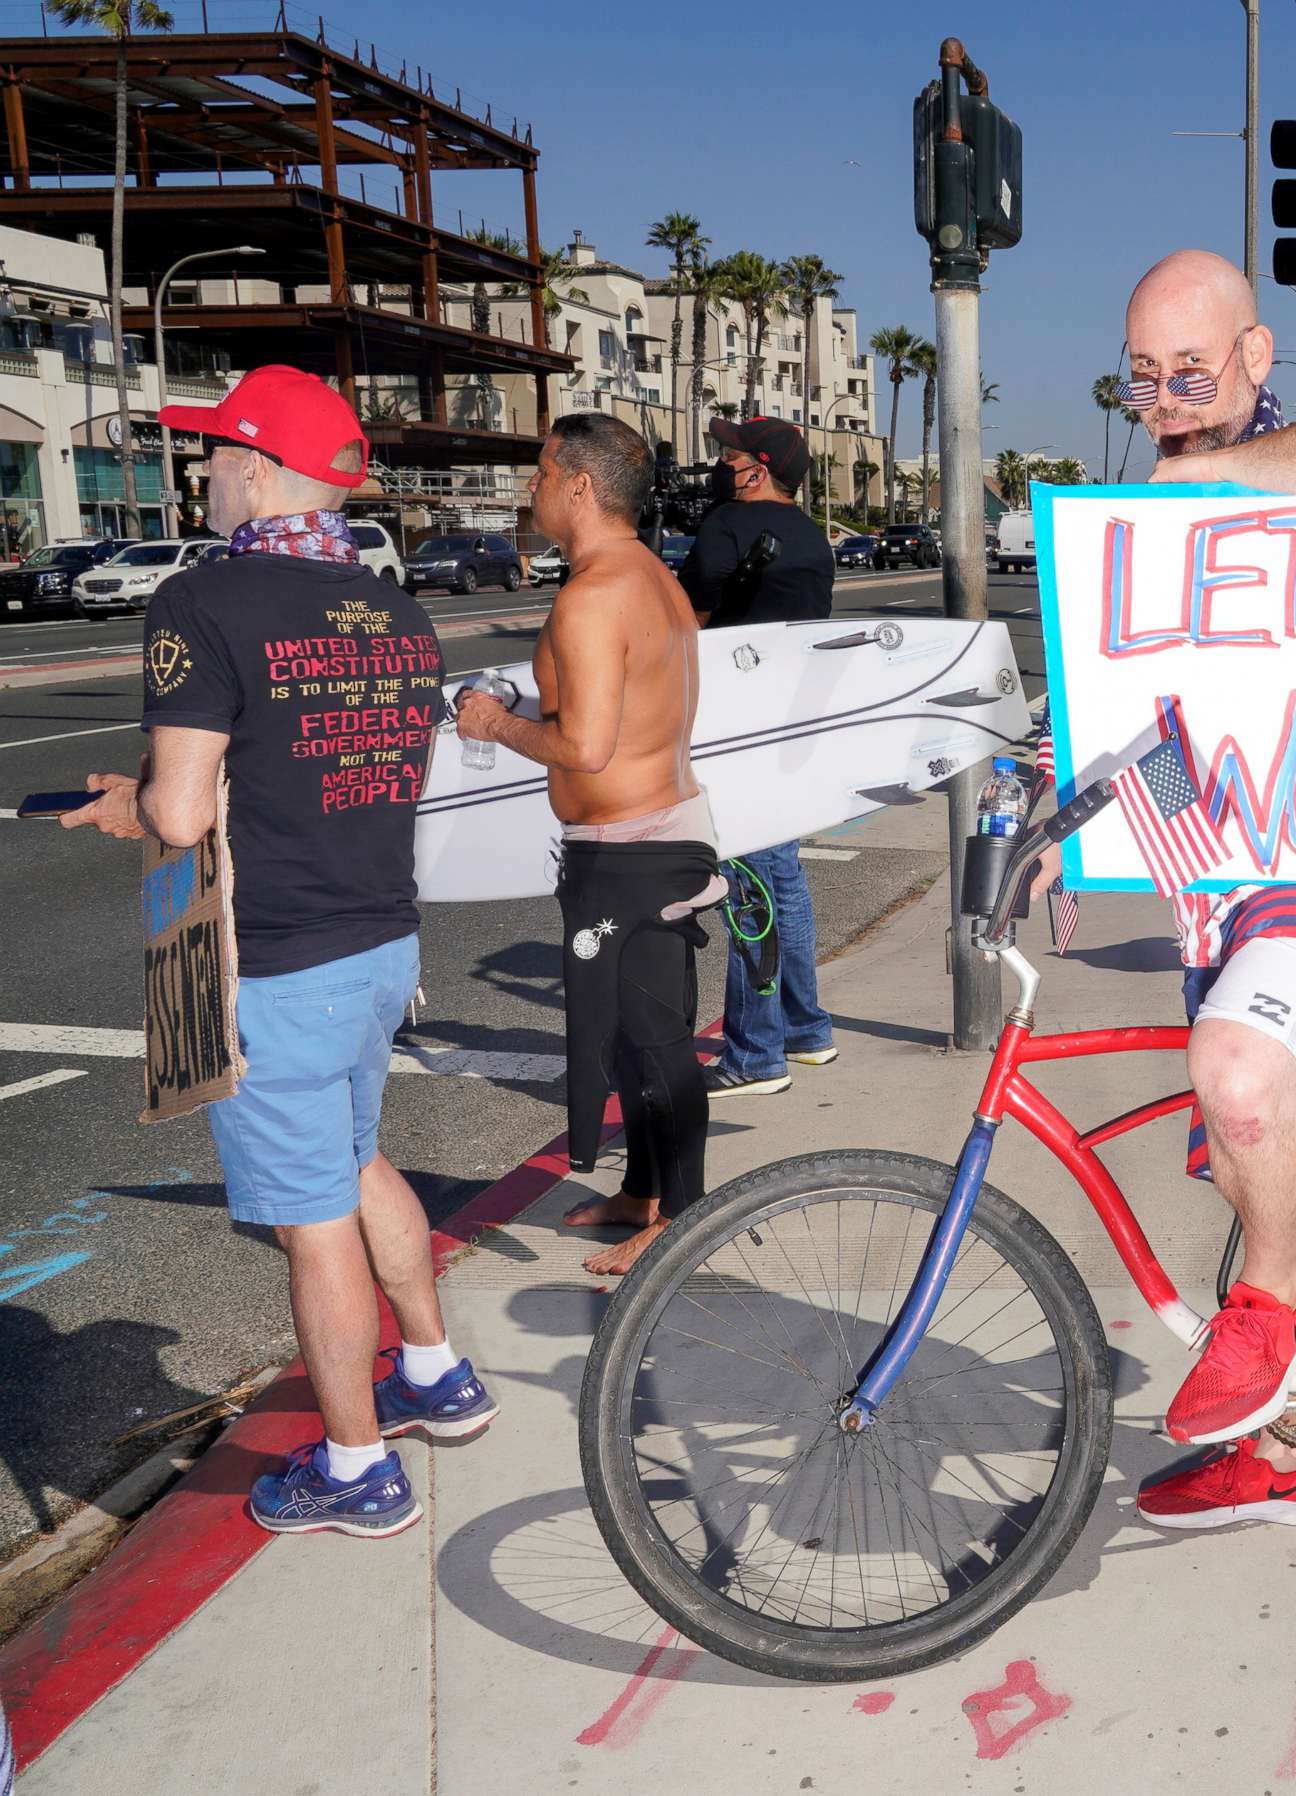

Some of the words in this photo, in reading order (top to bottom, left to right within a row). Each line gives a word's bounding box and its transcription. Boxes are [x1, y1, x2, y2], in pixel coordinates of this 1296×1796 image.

[341, 600, 370, 611] THE
[326, 611, 392, 623] PURPOSE
[337, 623, 354, 634] OF
[361, 623, 390, 634] THE
[264, 638, 358, 660] UNITED
[271, 687, 290, 699] IS
[300, 683, 321, 697] TO
[327, 680, 367, 694] LIMIT
[375, 678, 403, 691] THE
[411, 677, 440, 688] POWE
[345, 695, 364, 706] OF
[371, 692, 399, 705] THE
[300, 704, 433, 738] FEDERAL
[339, 753, 366, 766] NOT
[373, 750, 402, 762] THE
